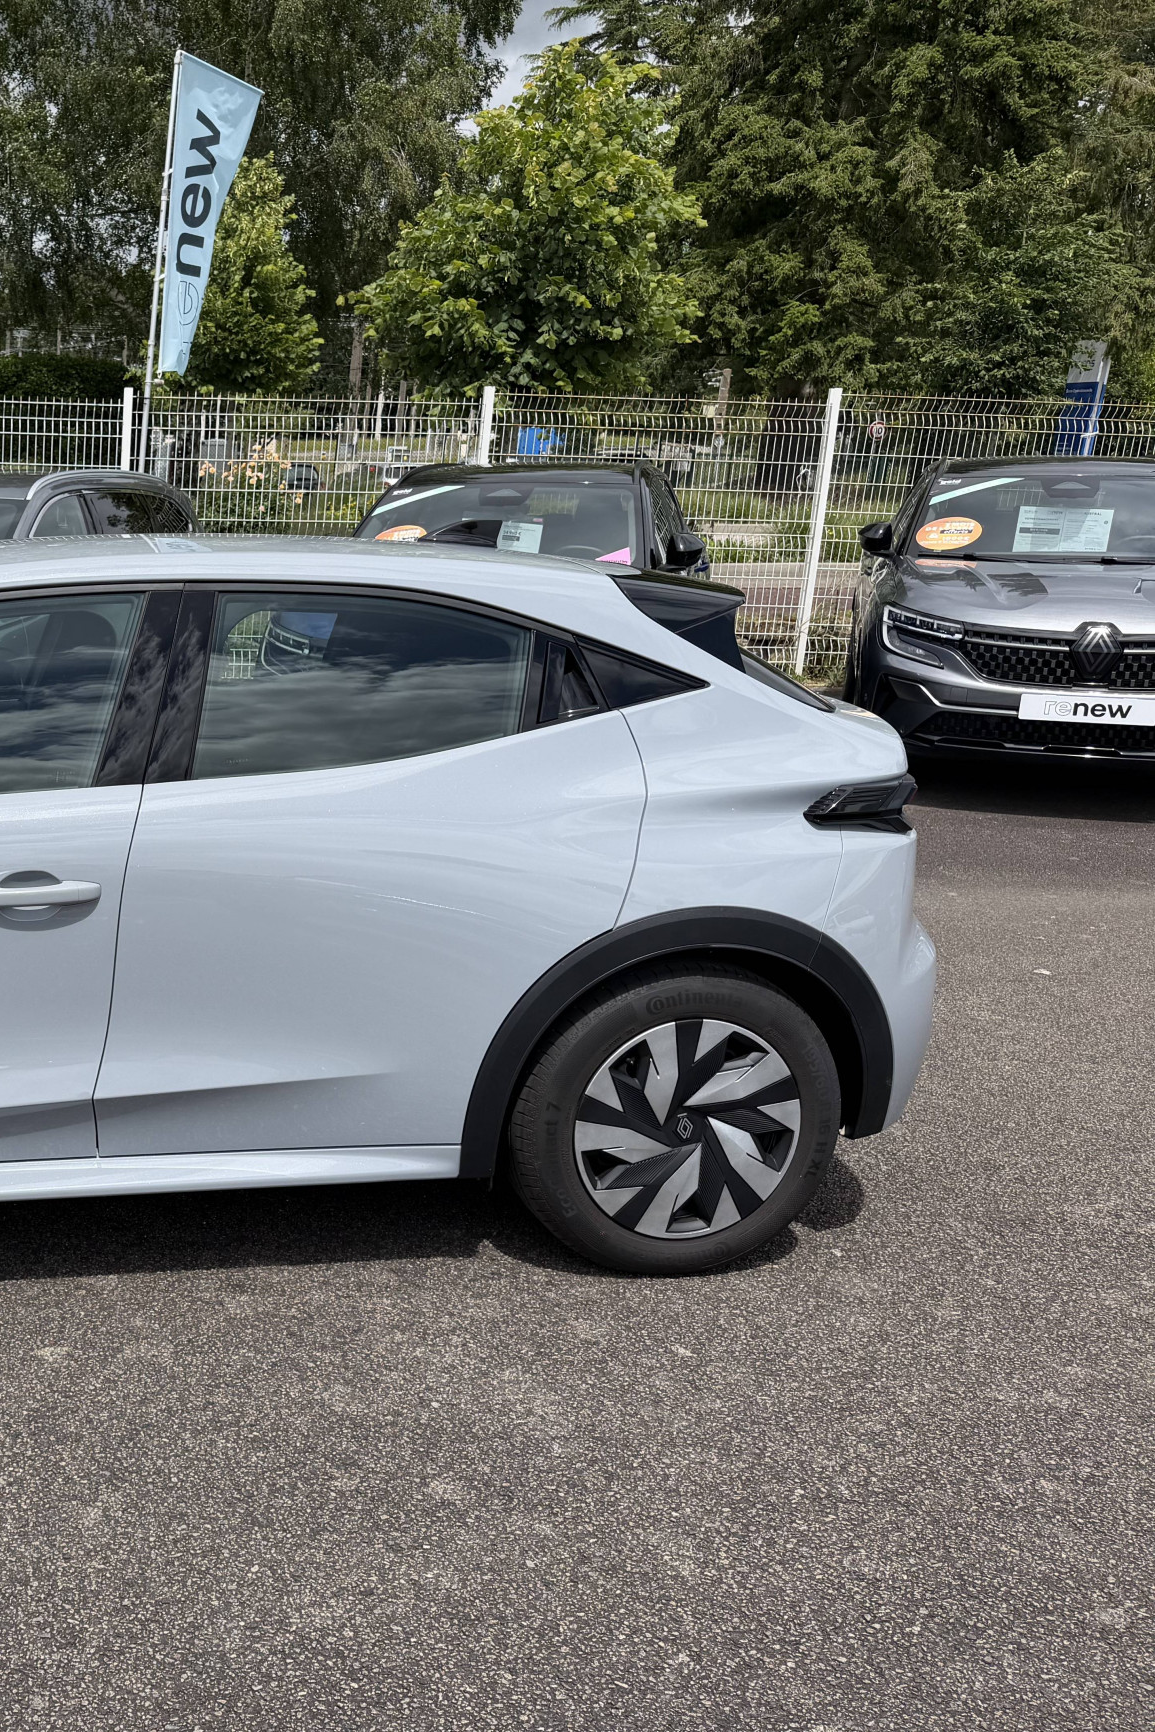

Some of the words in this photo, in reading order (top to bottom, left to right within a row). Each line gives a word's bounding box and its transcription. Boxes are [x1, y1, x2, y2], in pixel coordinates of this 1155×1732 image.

[874, 427, 883, 435] 10
[1043, 701, 1133, 719] renew
[646, 990, 745, 1016] Continenta
